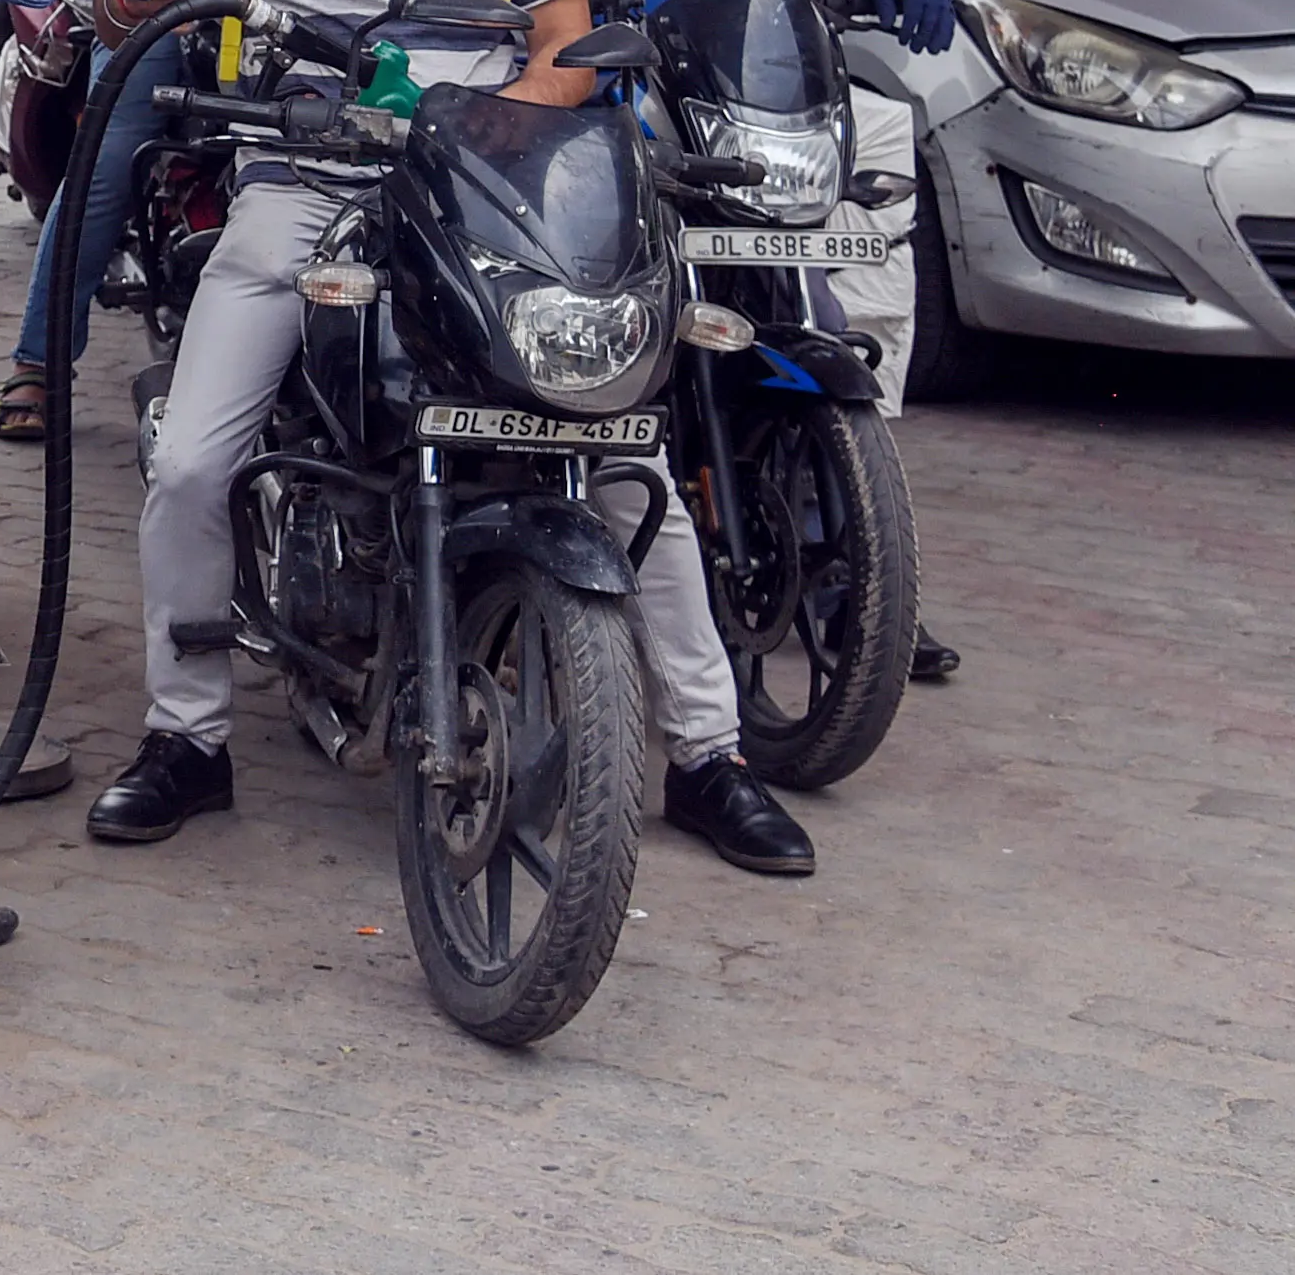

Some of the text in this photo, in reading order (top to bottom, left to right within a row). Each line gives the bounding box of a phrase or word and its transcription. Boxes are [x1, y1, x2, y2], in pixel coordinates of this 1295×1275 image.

[712, 234, 742, 257] DL
[754, 235, 813, 257] 6SBE
[825, 236, 884, 259] 8896
[451, 410, 484, 434] DL
